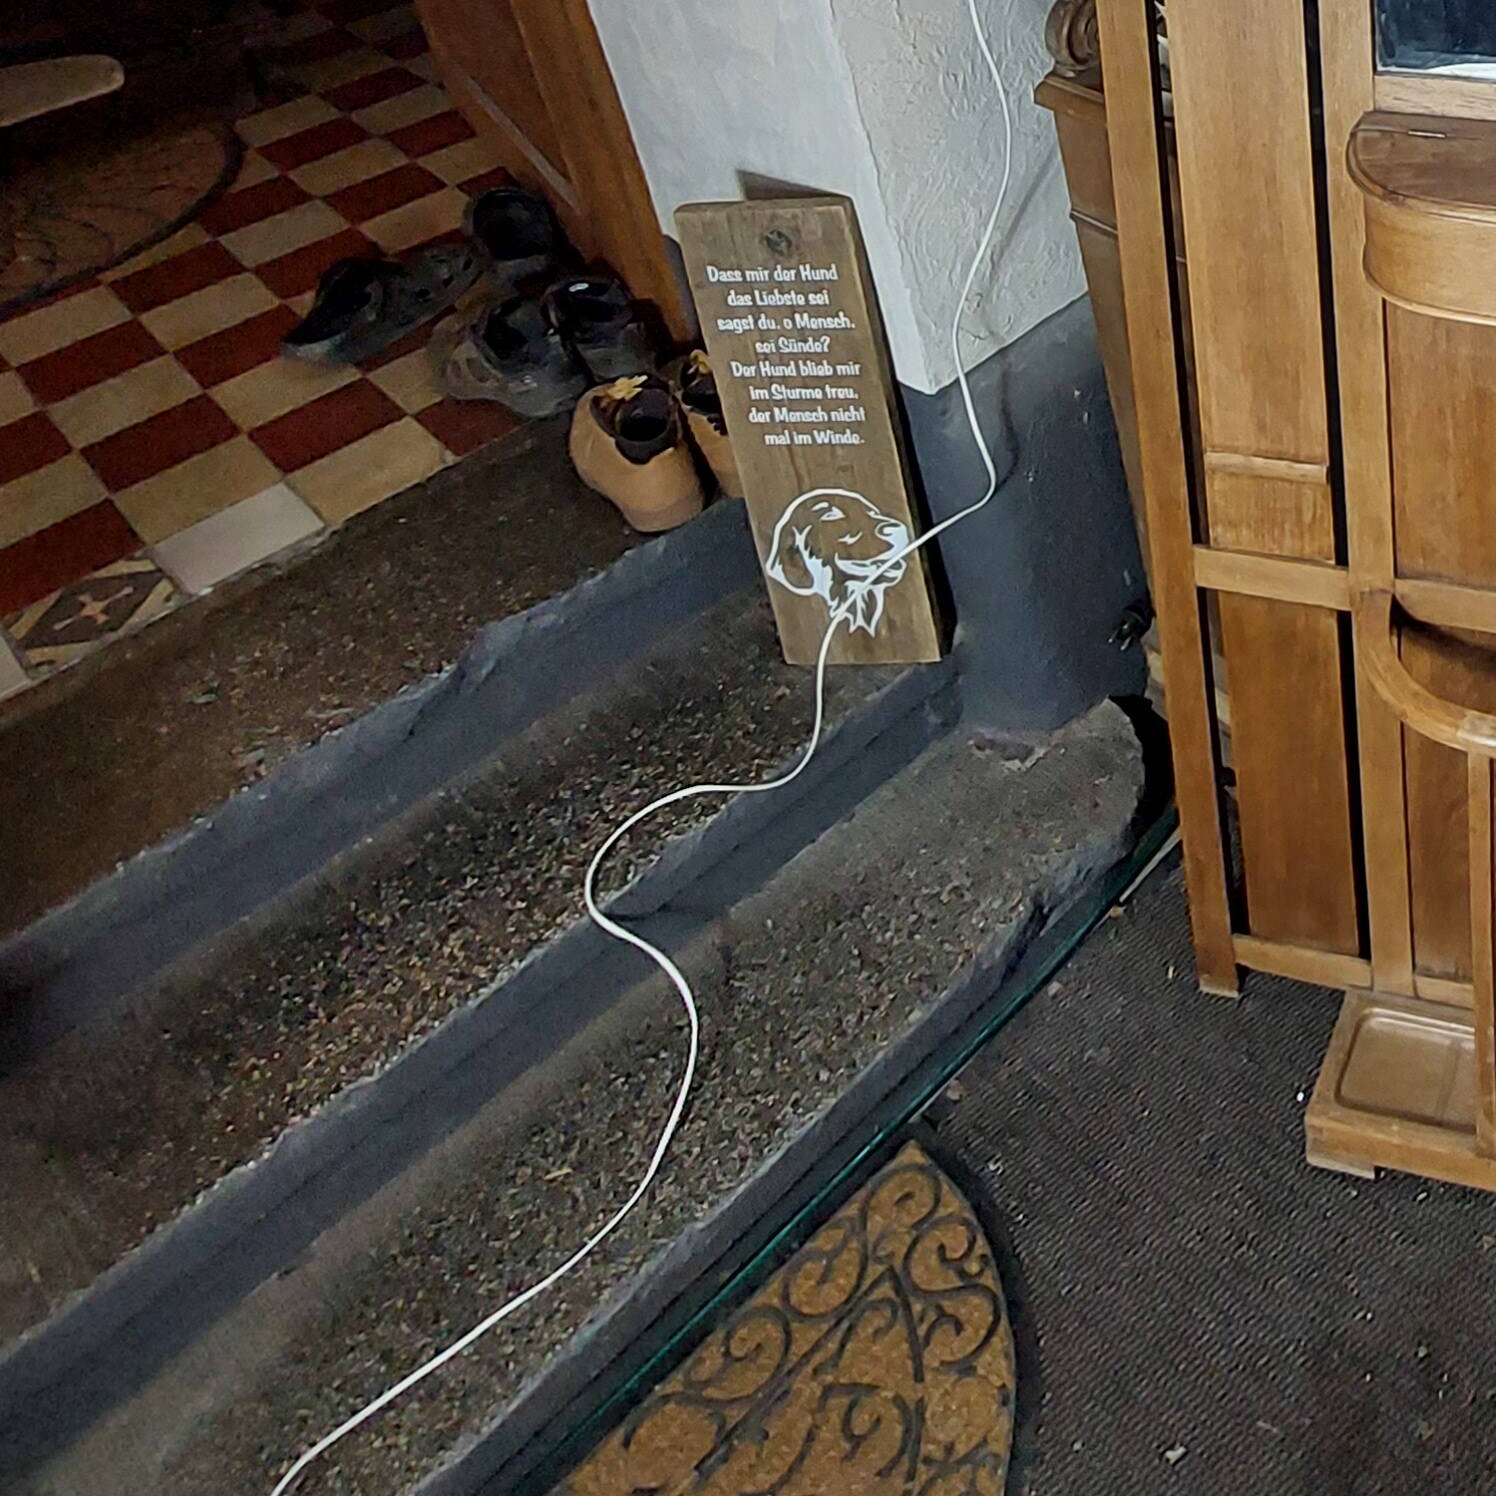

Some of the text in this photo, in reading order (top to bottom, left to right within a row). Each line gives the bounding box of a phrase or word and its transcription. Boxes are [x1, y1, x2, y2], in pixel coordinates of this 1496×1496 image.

[706, 263, 839, 282] Dass mir der Hund
[727, 289, 830, 306] das Liebste sei
[716, 314, 755, 334] sagst
[783, 318, 793, 330] o
[755, 335, 831, 354] sei Sünde?
[730, 359, 861, 377] Der Hund blieb mir
[748, 385, 770, 400] im
[771, 383, 823, 400] Sturme
[748, 405, 866, 423] der Mensch nicht
[764, 429, 791, 445] mal
[792, 430, 812, 445] im
